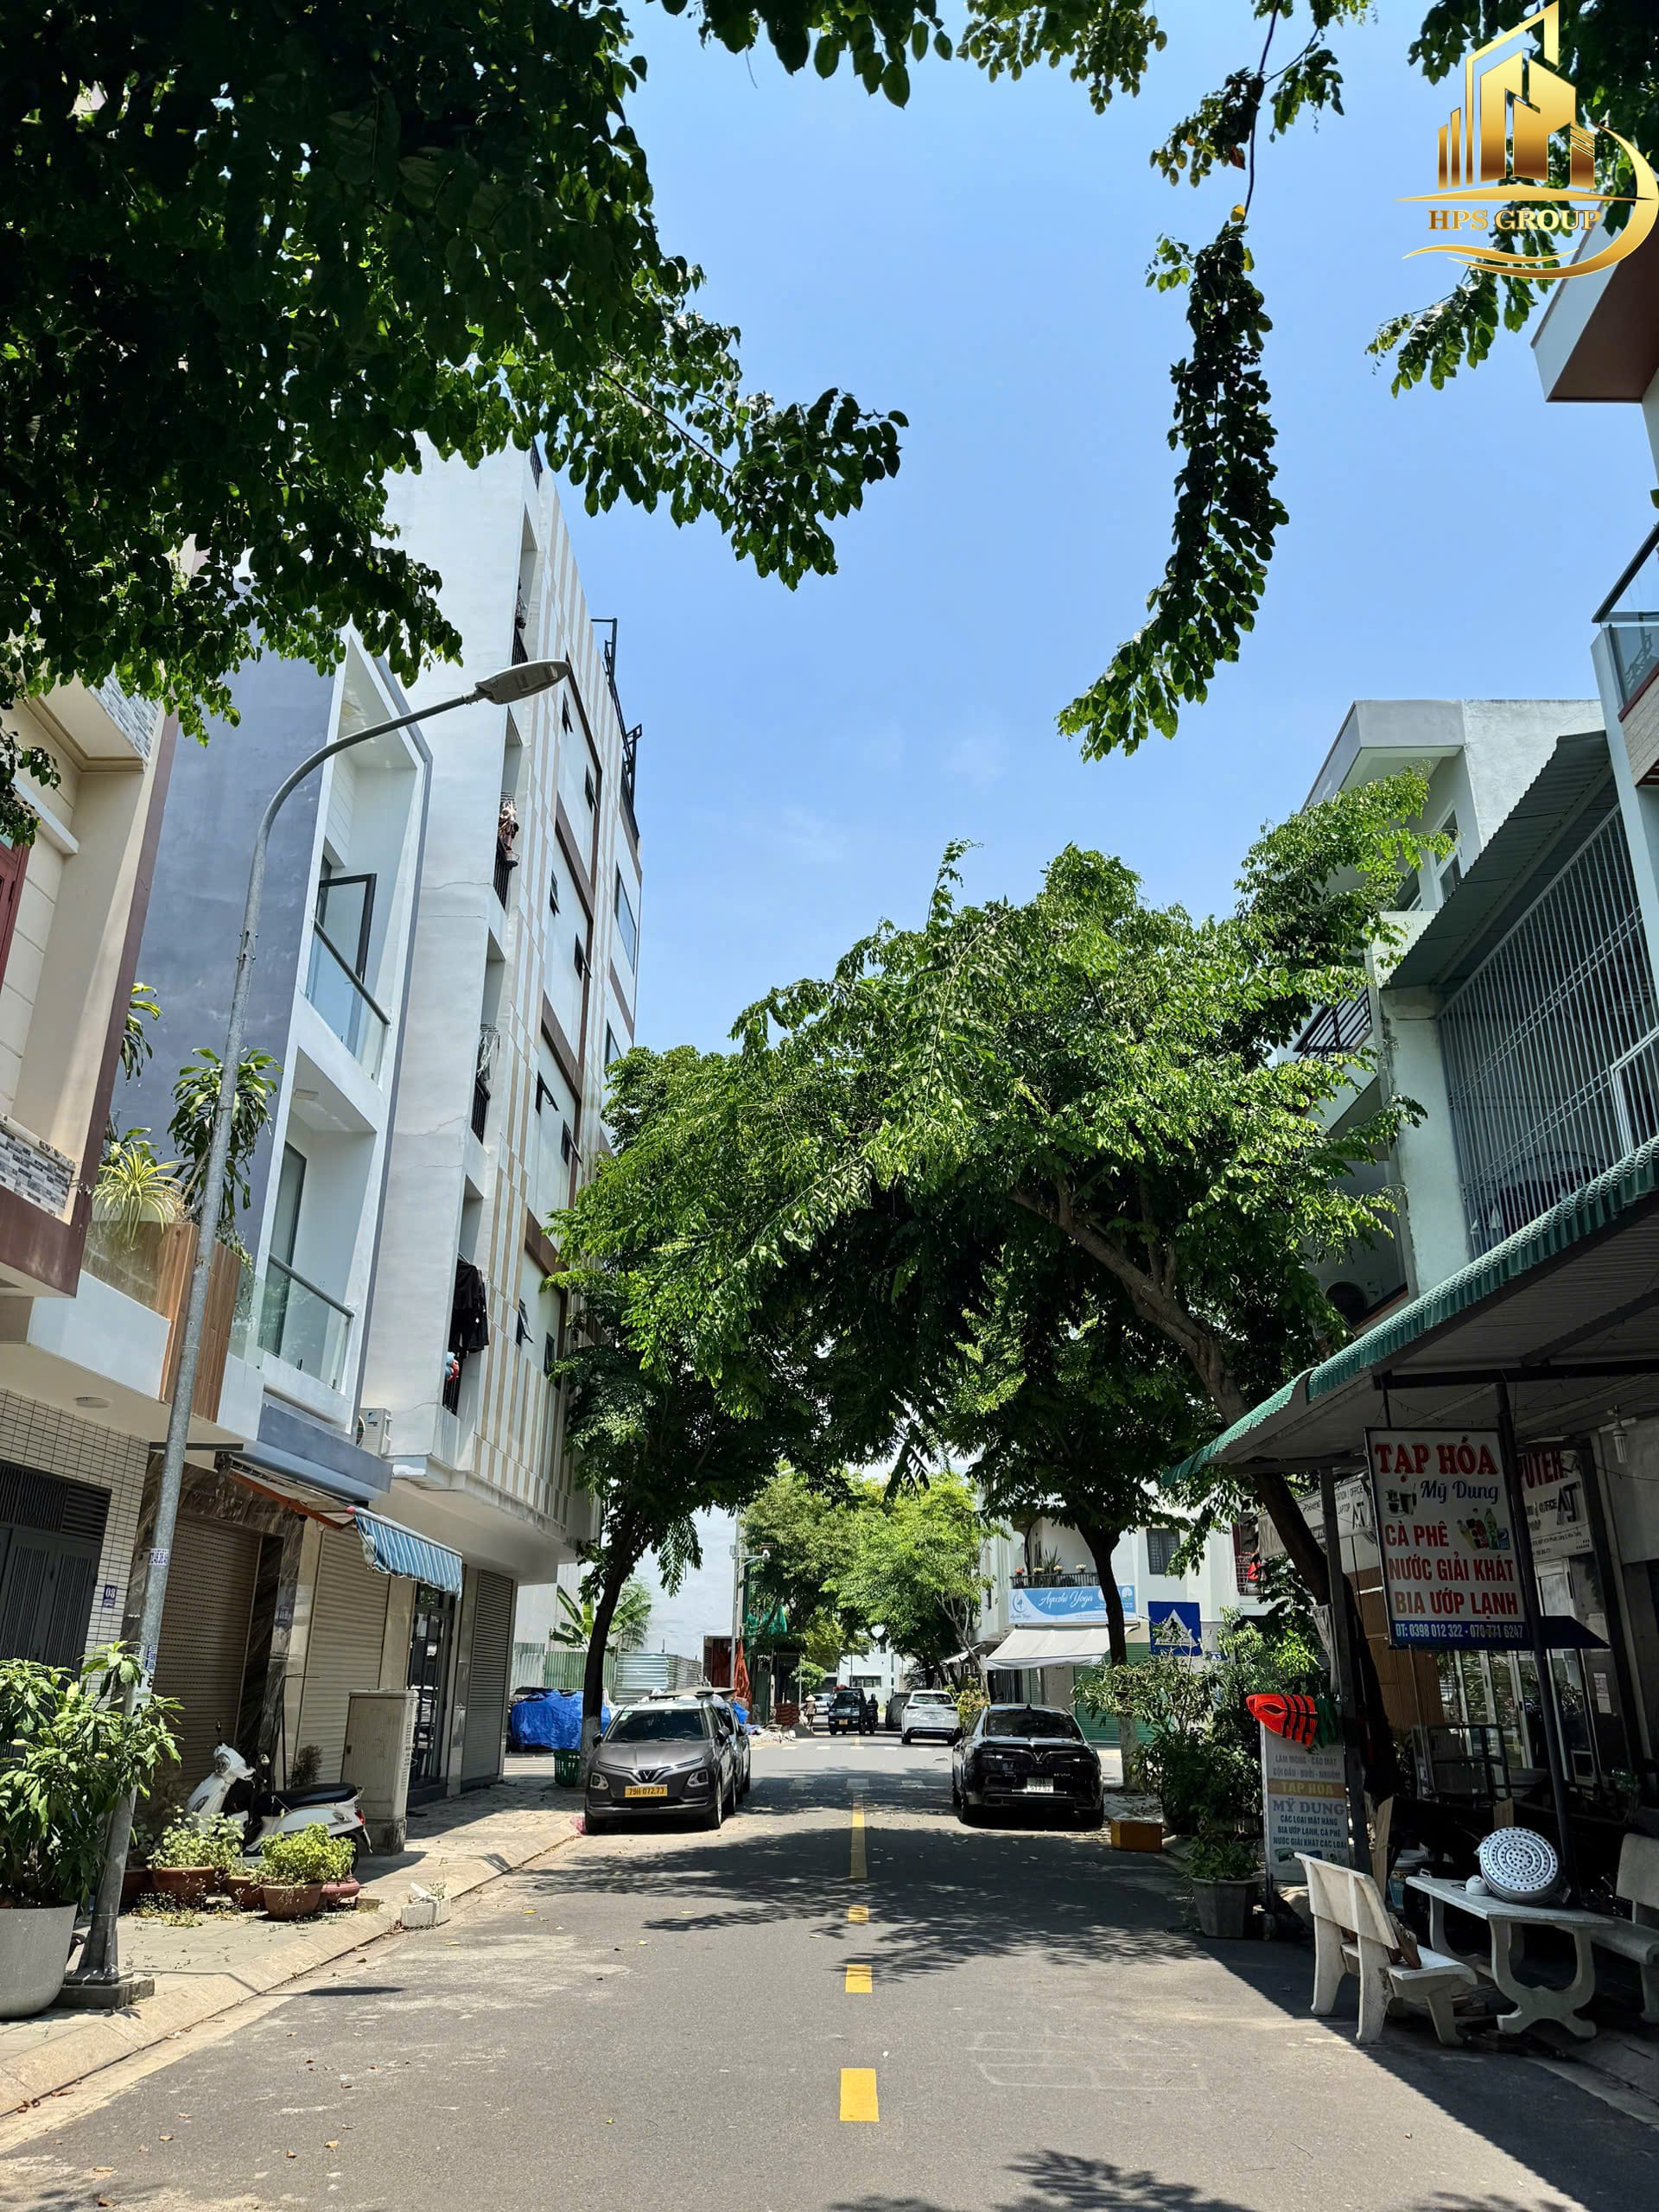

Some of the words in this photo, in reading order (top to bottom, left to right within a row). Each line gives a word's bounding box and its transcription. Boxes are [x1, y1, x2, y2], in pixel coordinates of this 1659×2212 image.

[1375, 1442, 1430, 1483] TẠP
[1436, 1434, 1499, 1475] HÓA
[1421, 1479, 1448, 1503] Mỹ
[1452, 1480, 1499, 1504] Dung
[1385, 1521, 1409, 1548] CÀ
[1413, 1521, 1450, 1548] PHÊ
[1389, 1554, 1433, 1581] NƯỚC
[1436, 1551, 1470, 1581] GIẢI
[1473, 1555, 1514, 1581] KHÁT
[105, 1587, 116, 1599] 08
[1069, 1590, 1093, 1607] Yoga
[1395, 1591, 1426, 1614] BIA
[1430, 1587, 1465, 1614] ƯỚP
[1471, 1592, 1518, 1620] LẠNH
[1409, 1623, 1429, 1637] 0398
[1431, 1624, 1446, 1637] 012
[1448, 1624, 1463, 1637] 322
[1300, 1801, 1345, 1815] DUNG
